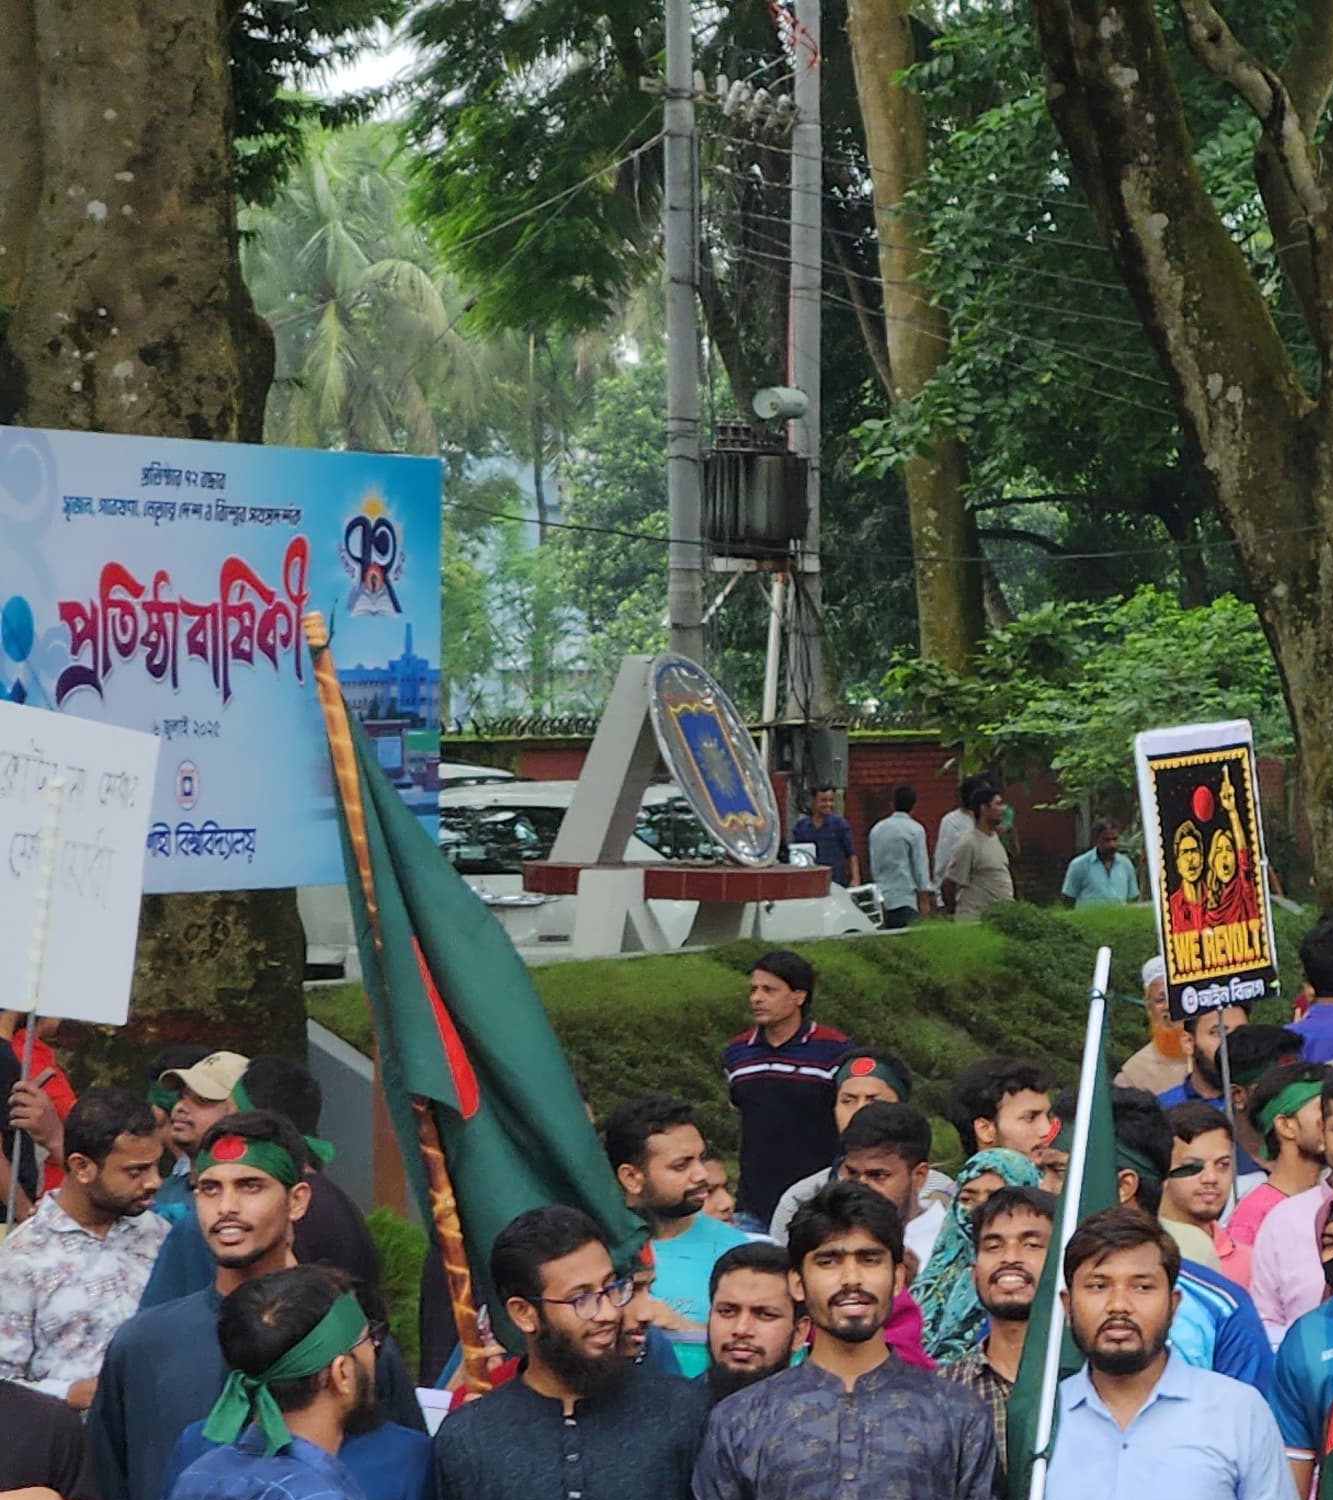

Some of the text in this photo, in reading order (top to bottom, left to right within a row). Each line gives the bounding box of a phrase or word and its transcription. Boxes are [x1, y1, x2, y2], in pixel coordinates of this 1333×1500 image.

[175, 819, 257, 865] বিশ্ববিদ্যালয়
[1173, 918, 1262, 974] WE REVOLT
[1197, 976, 1266, 1008] আইন বিভাগ
